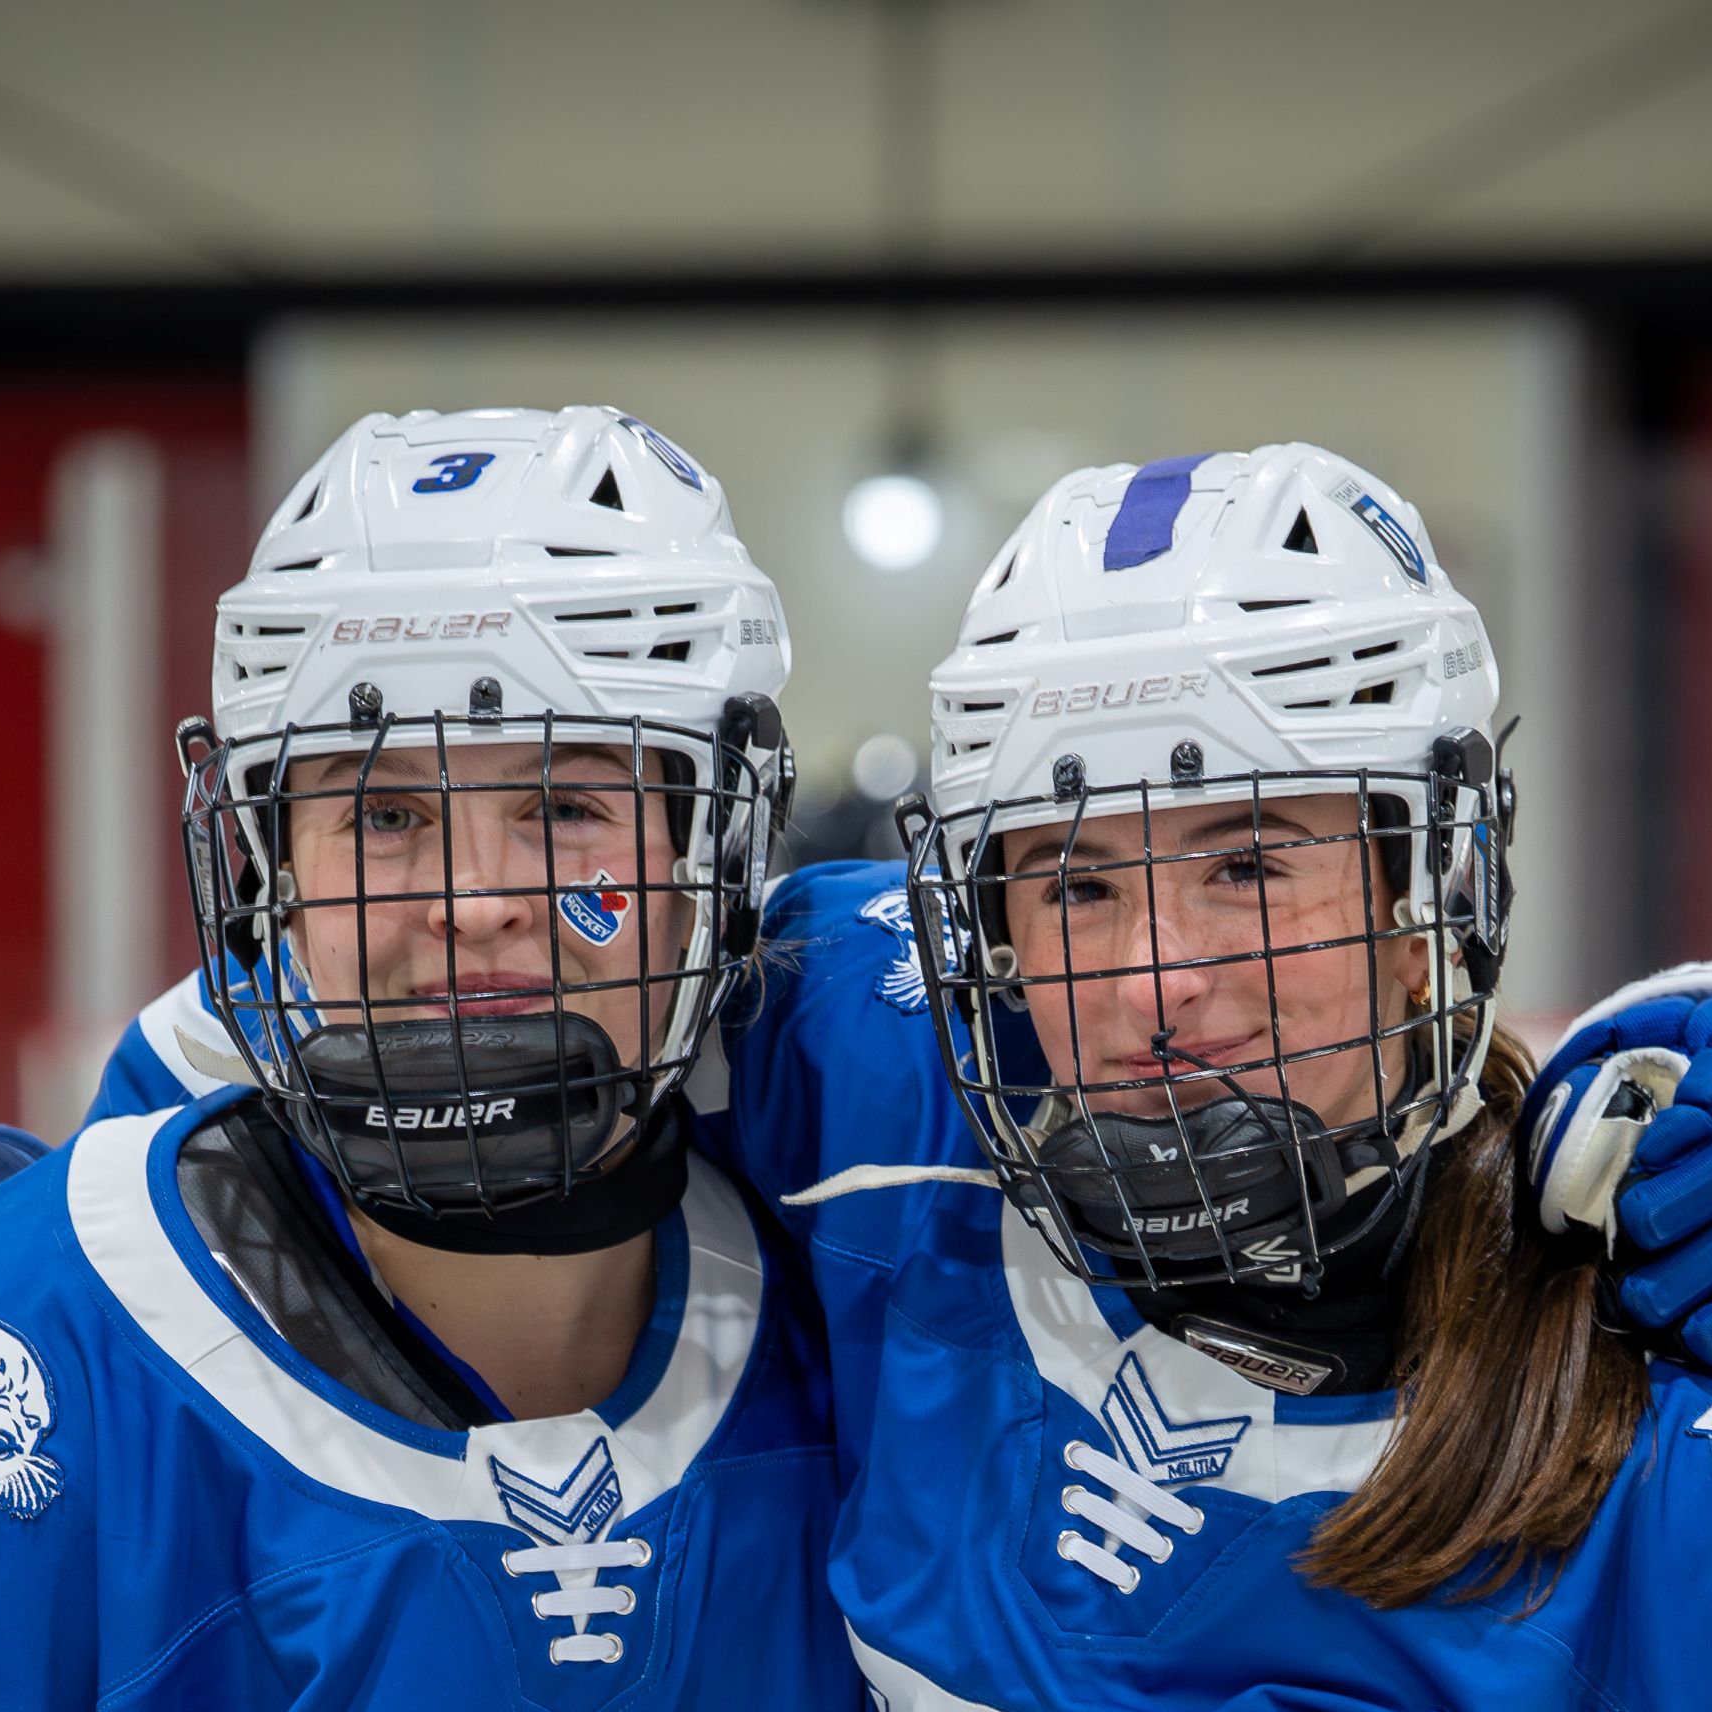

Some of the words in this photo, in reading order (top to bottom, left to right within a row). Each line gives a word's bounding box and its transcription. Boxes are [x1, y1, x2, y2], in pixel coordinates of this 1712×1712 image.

[412, 452, 497, 494] 3
[564, 893, 612, 938] HOCKEY
[1168, 1456, 1220, 1480] MILITIA
[582, 1486, 619, 1535] MILITIA
